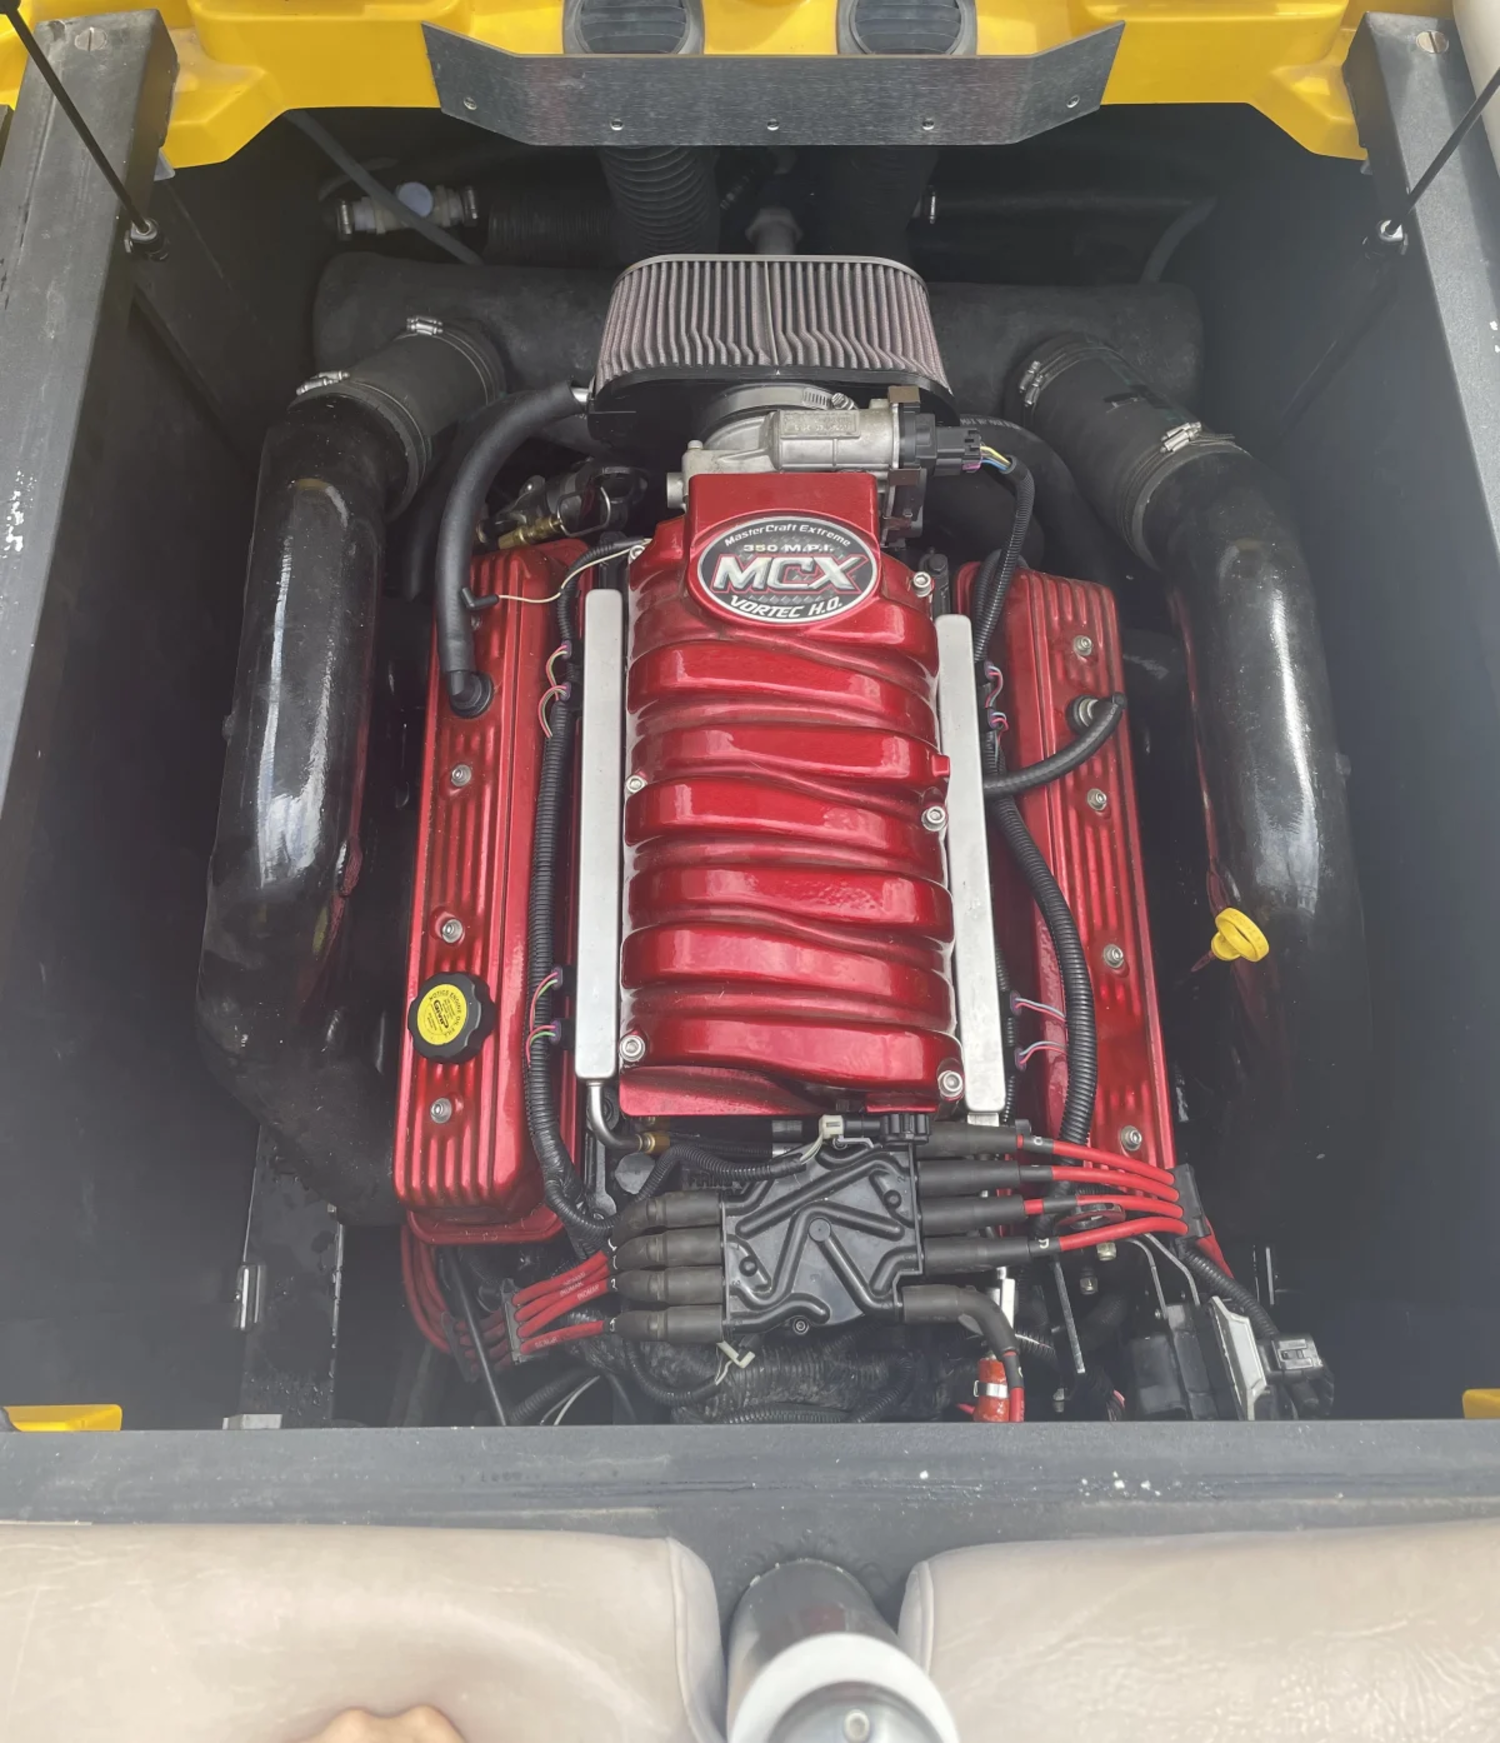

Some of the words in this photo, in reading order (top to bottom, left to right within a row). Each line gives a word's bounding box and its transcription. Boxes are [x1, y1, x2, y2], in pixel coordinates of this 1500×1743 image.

[724, 523, 798, 547] MasterCraft
[799, 524, 852, 547] Extreme
[743, 544, 778, 553] 350
[711, 555, 865, 591] MCX
[730, 595, 805, 618] VORTEC
